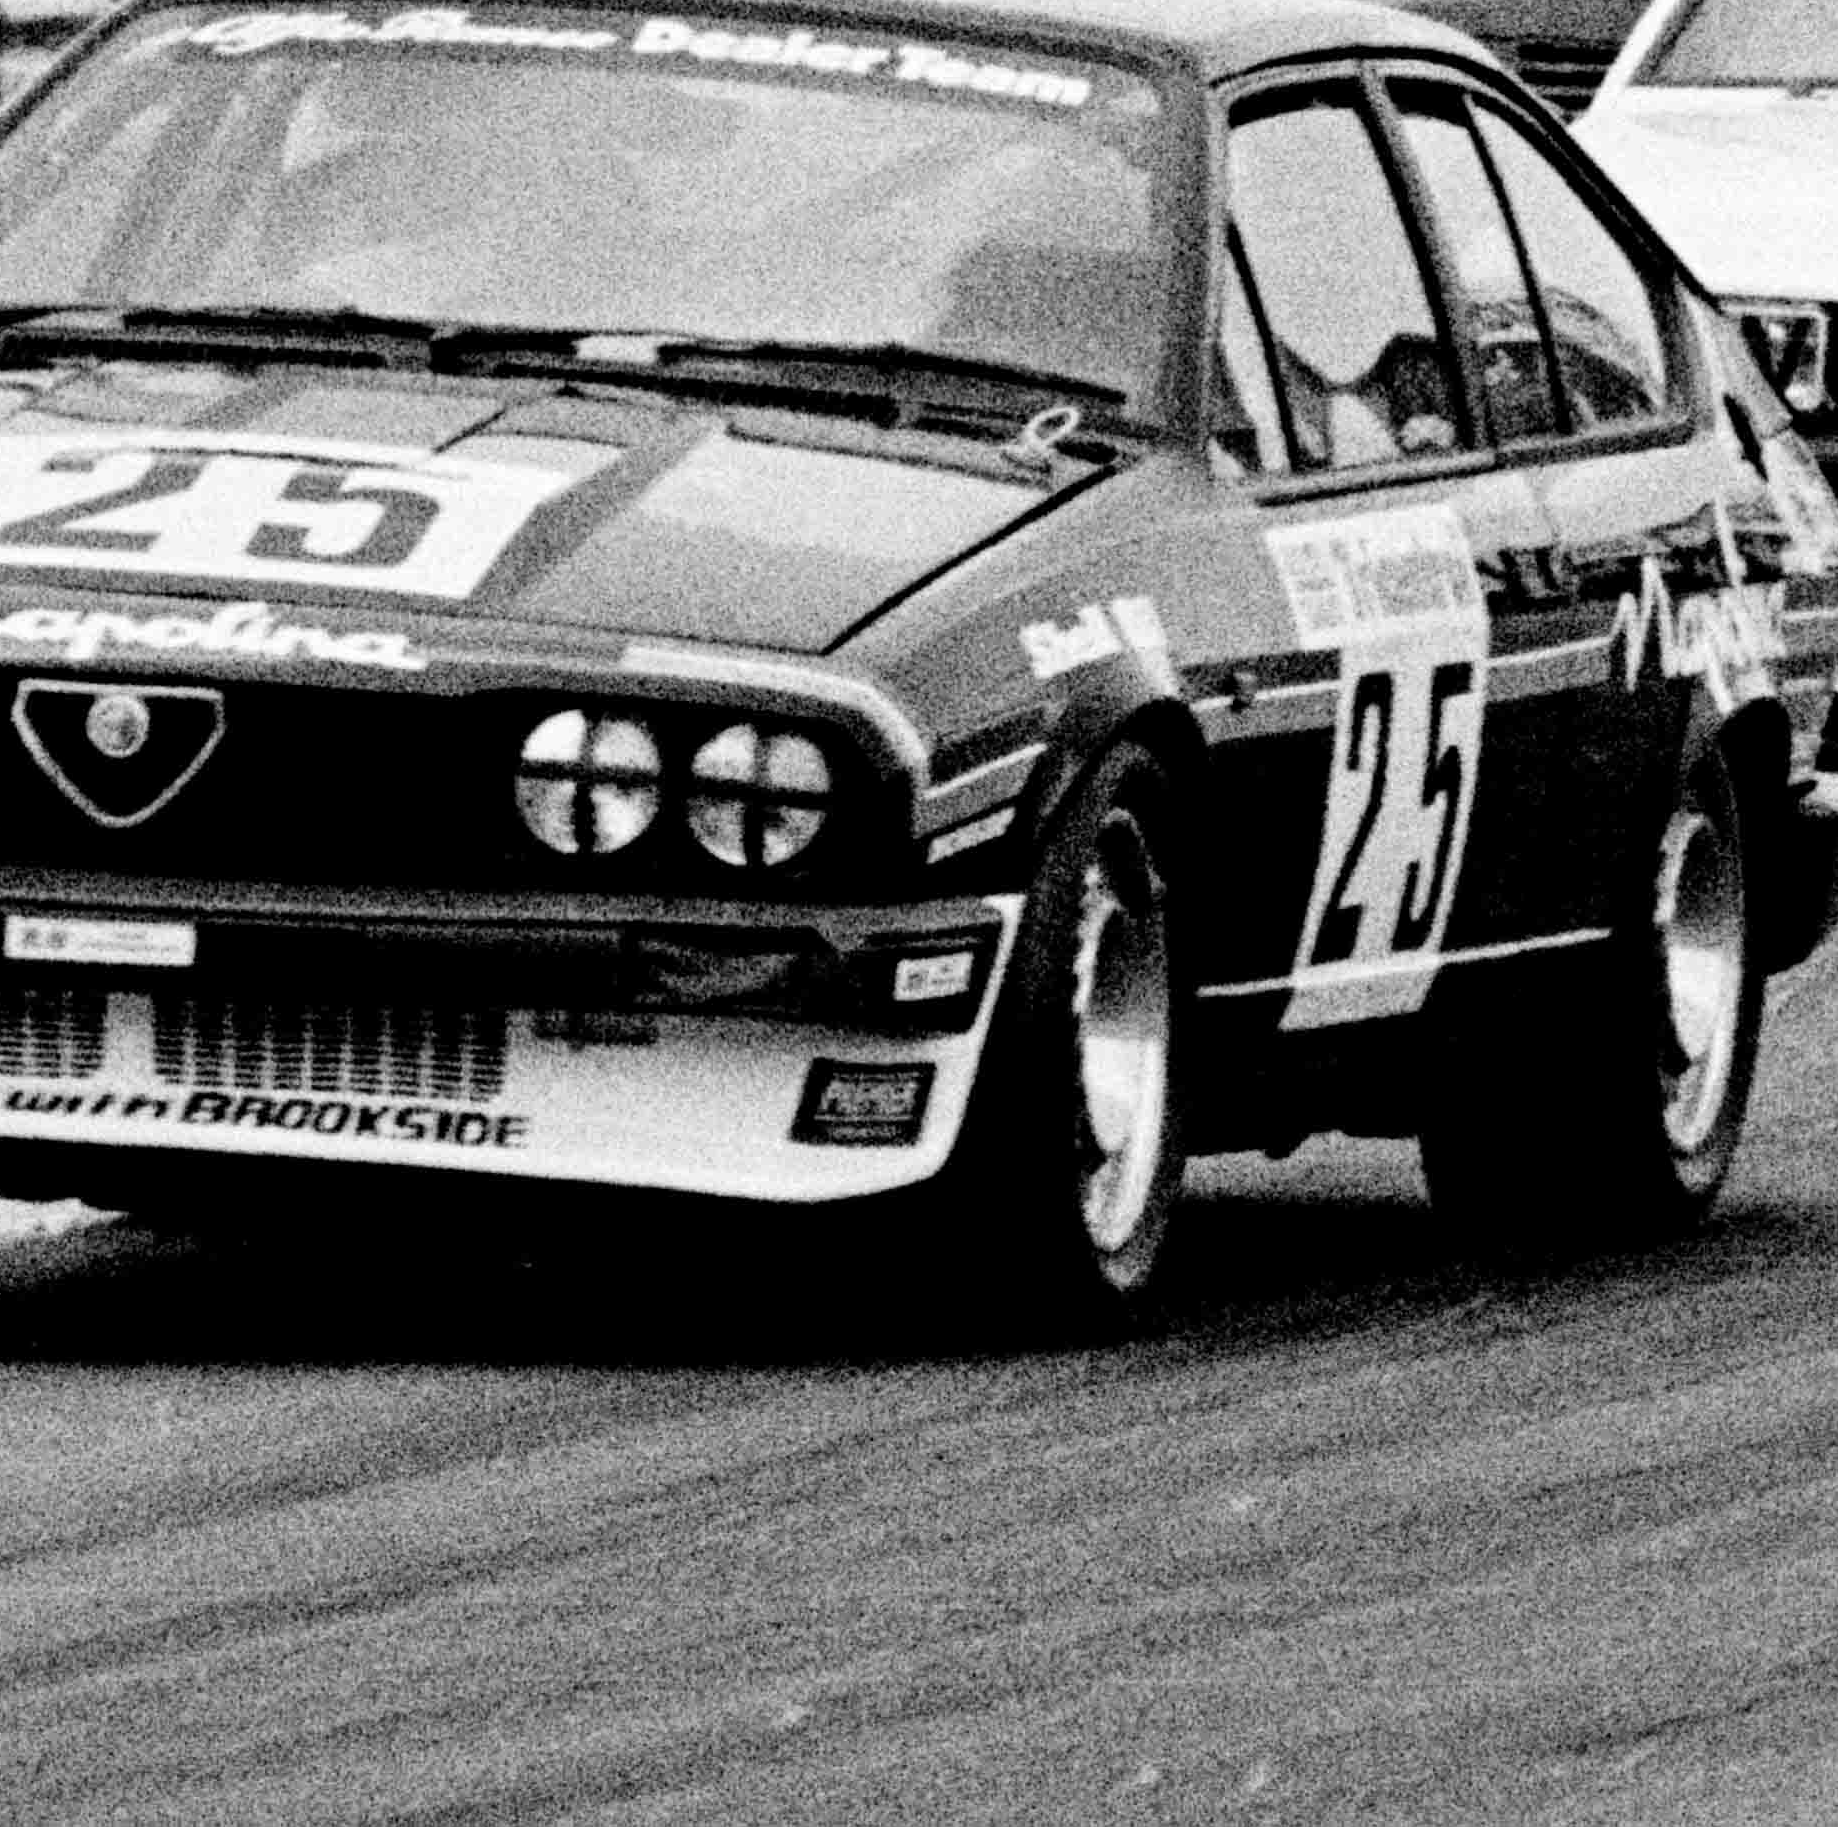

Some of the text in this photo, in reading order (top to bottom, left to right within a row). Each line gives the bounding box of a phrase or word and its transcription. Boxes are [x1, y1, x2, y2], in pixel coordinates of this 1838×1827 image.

[633, 19, 890, 74] Dealer
[896, 43, 1090, 106] Team
[1310, 661, 1473, 966] 25
[179, 1090, 531, 1149] BROOKSIDE
